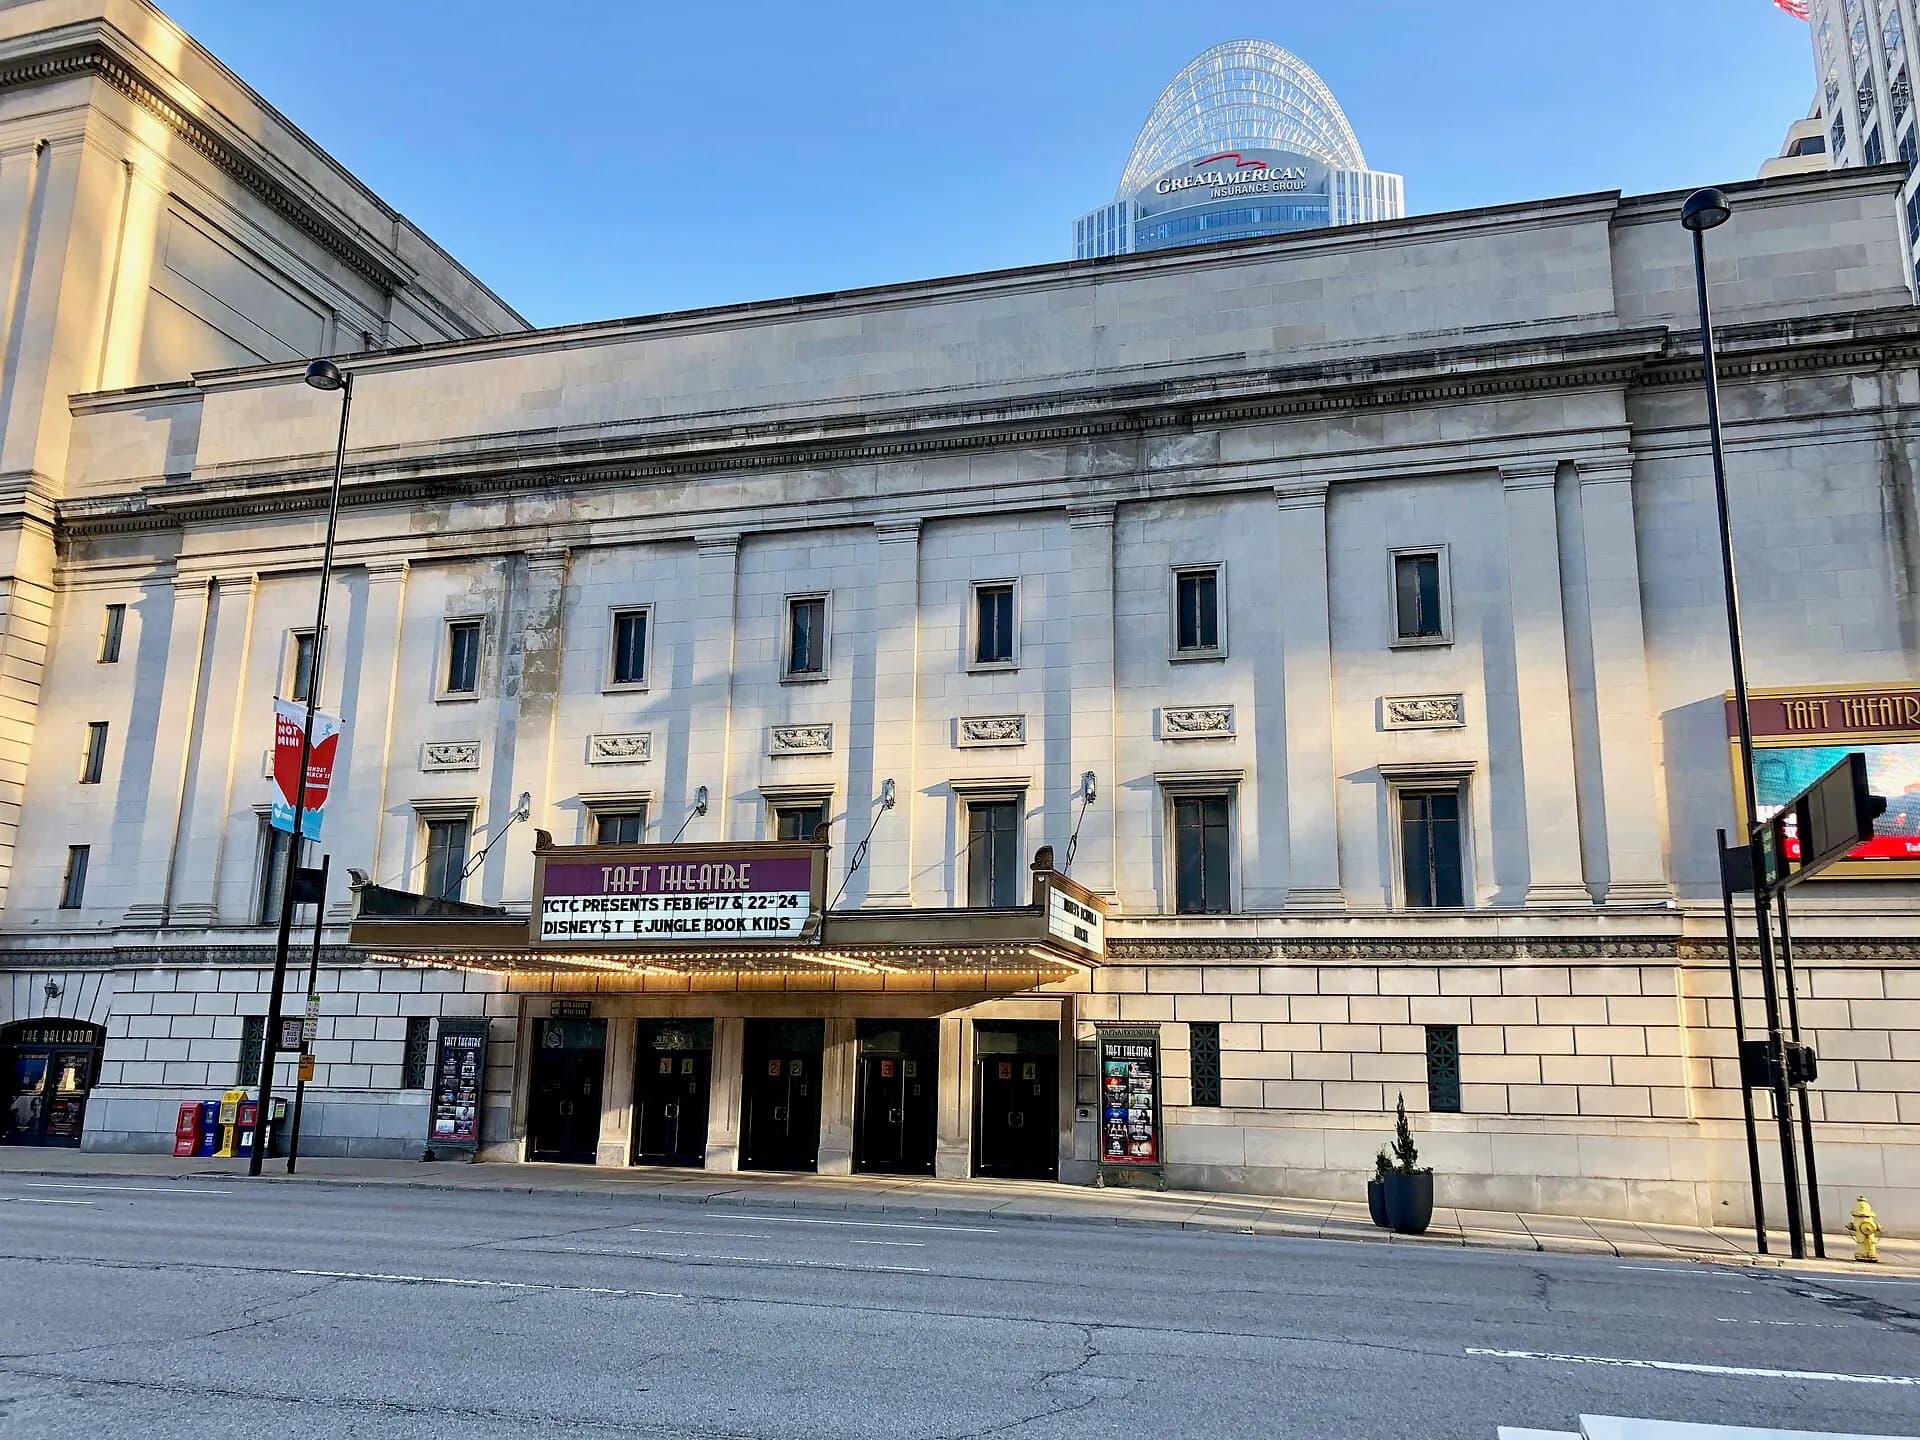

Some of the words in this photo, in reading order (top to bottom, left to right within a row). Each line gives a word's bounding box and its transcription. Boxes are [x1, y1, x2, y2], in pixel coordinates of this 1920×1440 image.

[1210, 183, 1268, 198] INSURANCE
[1272, 181, 1307, 192] GROUP
[1782, 700, 1830, 729] TAFT
[278, 725, 299, 735] NOT
[278, 736, 299, 747] MINI
[601, 866, 652, 892] TAFT
[658, 863, 751, 891] THEATRE
[543, 900, 580, 913] TCTC
[582, 898, 659, 912] PRESENTS
[663, 897, 692, 910] FEB
[732, 896, 743, 909] &
[543, 920, 611, 934] DISNEY'S
[645, 919, 701, 932] JUNGLE
[704, 918, 747, 932] BOOK
[752, 917, 791, 931] KIDS
[22, 1030, 39, 1042] THE
[43, 1030, 93, 1043] BALLROOM
[444, 1036, 457, 1047] TAFT
[458, 1036, 482, 1047] THEATRE
[1105, 1045, 1121, 1057] TAFT
[1123, 1045, 1153, 1058] THEATRE
